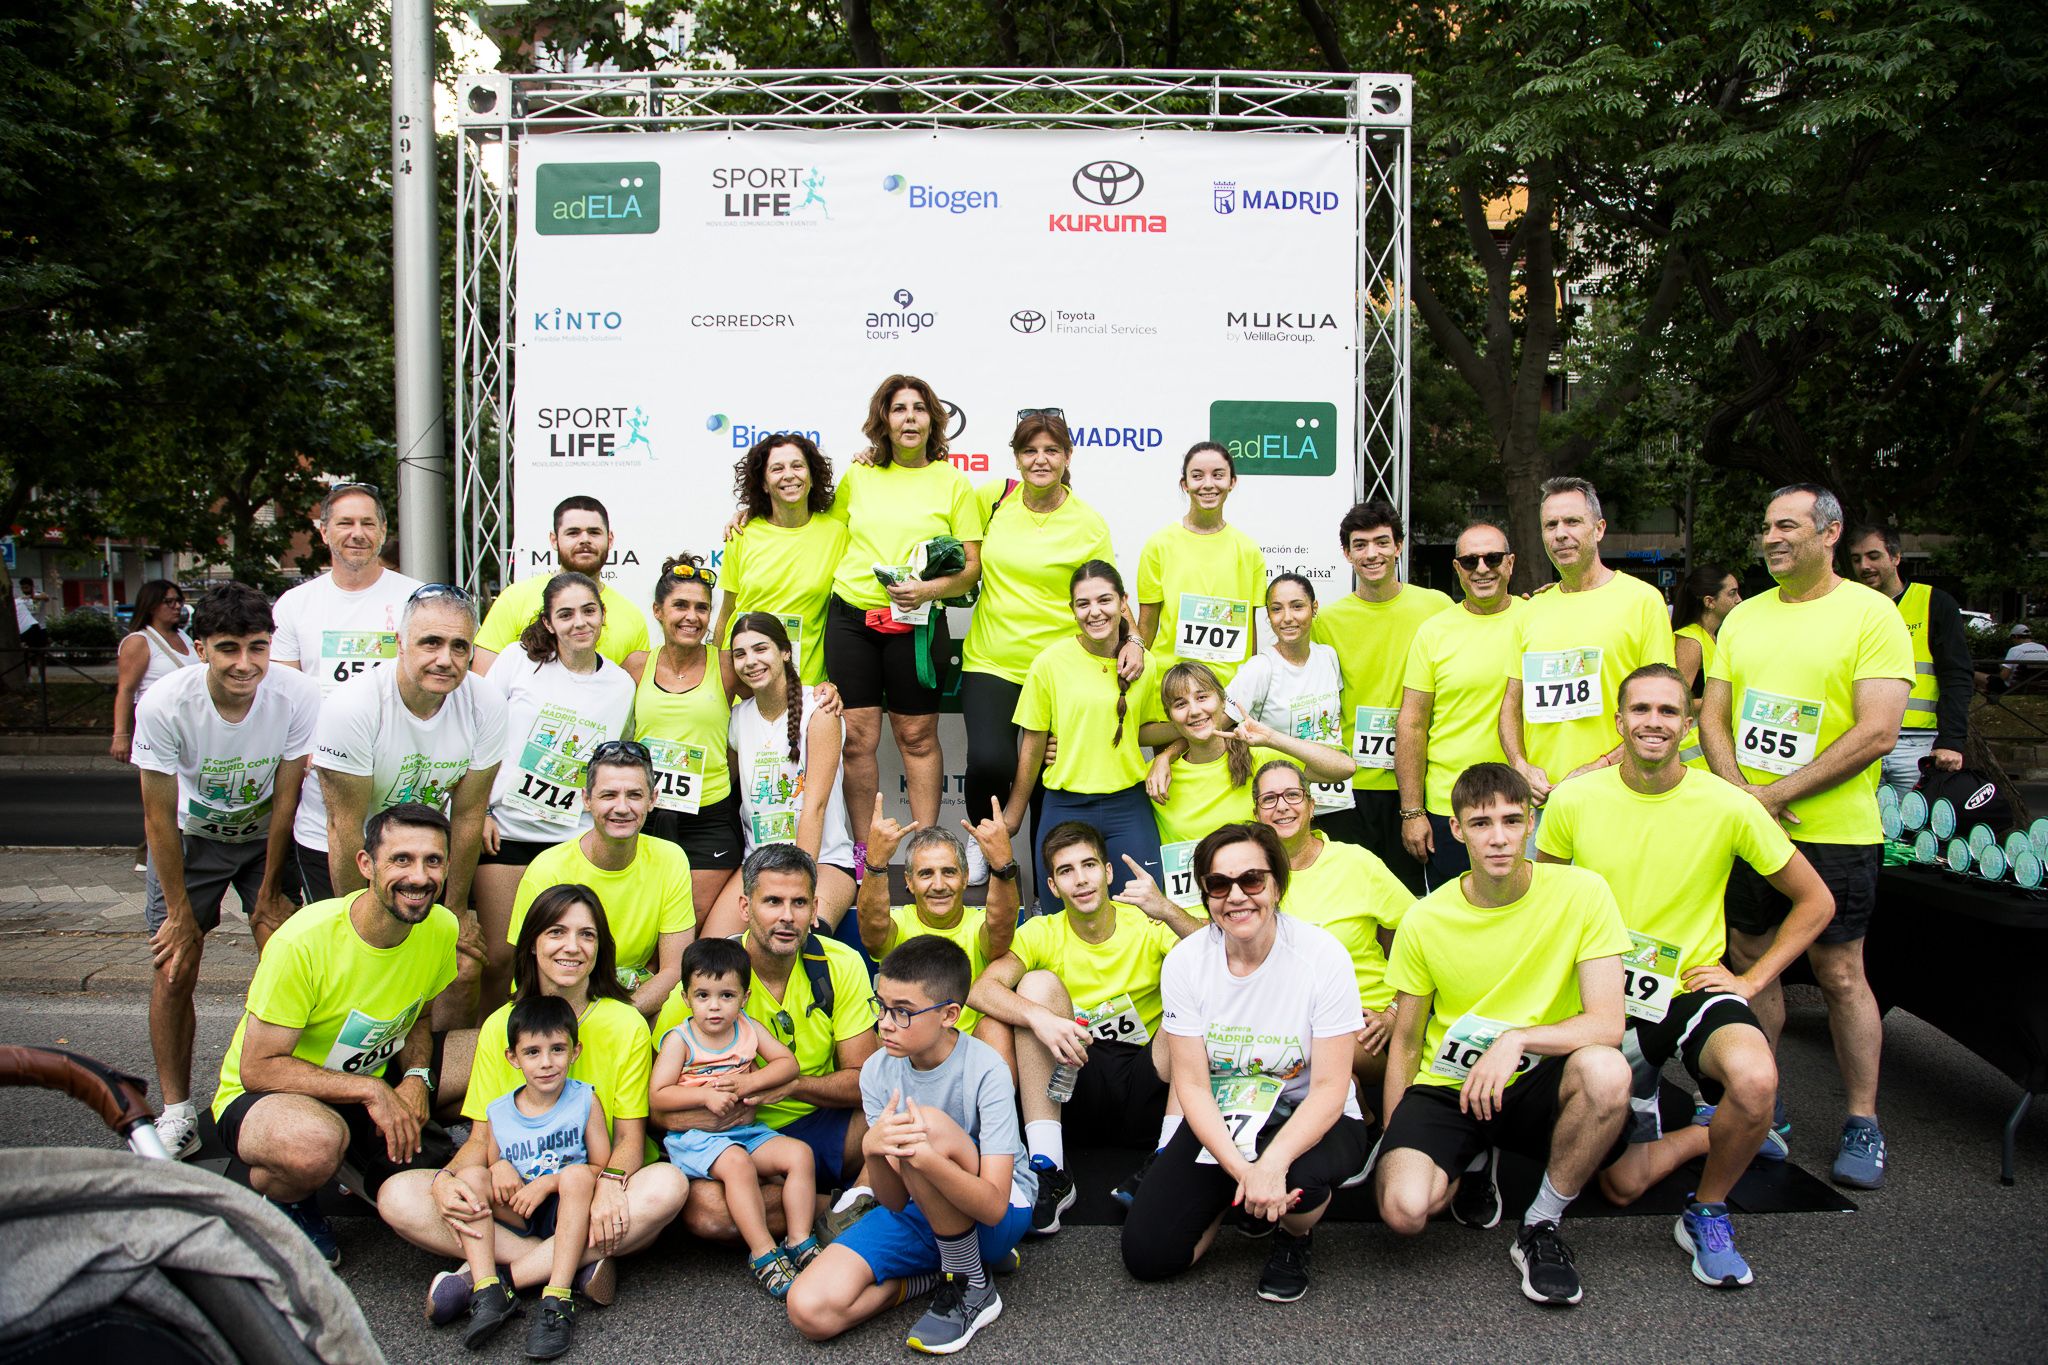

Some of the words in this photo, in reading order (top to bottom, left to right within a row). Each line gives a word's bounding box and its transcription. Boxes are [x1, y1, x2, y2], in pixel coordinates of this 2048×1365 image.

[712, 167, 804, 189] SPORT
[553, 195, 643, 220] adELA
[724, 193, 791, 217] LIFE
[909, 185, 999, 214] Biogen
[1243, 190, 1339, 215] MADRID
[866, 313, 934, 333] amigo
[1057, 310, 1095, 322] Toyota
[1227, 312, 1338, 329] MUKUA
[866, 330, 900, 340] tours
[1057, 324, 1108, 334] Financial
[1111, 324, 1158, 335] Services
[1226, 331, 1240, 343] by
[1243, 331, 1316, 344] VelillaGroup.
[538, 407, 628, 429] SPORT
[550, 433, 616, 457] LIFE
[732, 425, 821, 448] Bin
[1067, 427, 1163, 452] MADRID
[531, 550, 640, 566] MUA
[1294, 545, 1309, 554] de:
[1193, 602, 1233, 623] ELA
[1183, 624, 1240, 649] 1707
[1906, 622, 1923, 631] ORT
[1541, 655, 1585, 679] ELA
[1535, 680, 1590, 708] 1718
[540, 709, 577, 723] MADRID
[578, 718, 597, 729] CON
[597, 723, 607, 731] LA
[1369, 714, 1396, 731] EL
[1751, 700, 1800, 727] ELA
[318, 744, 348, 759] UKUA
[1359, 735, 1396, 756] 170
[1744, 727, 1798, 758] 655
[202, 763, 245, 773] MADRID
[247, 758, 269, 768] CON
[434, 761, 457, 769] CON
[458, 758, 470, 767] LA
[534, 755, 580, 785] ELA
[755, 757, 779, 765] MADRID
[518, 773, 576, 811] 1714
[654, 770, 691, 797] 715
[201, 822, 259, 836] 456
[1171, 872, 1192, 896] 17
[1624, 969, 1659, 1002] 19
[1090, 1014, 1136, 1041] 56
[1207, 1032, 1254, 1043] MADRID
[1256, 1034, 1281, 1044] CON
[1285, 1035, 1300, 1045] LA
[1220, 1025, 1252, 1033] Carrera
[342, 1037, 397, 1073] 660
[505, 1140, 535, 1164] GOAL
[537, 1127, 579, 1155] RUSH!
